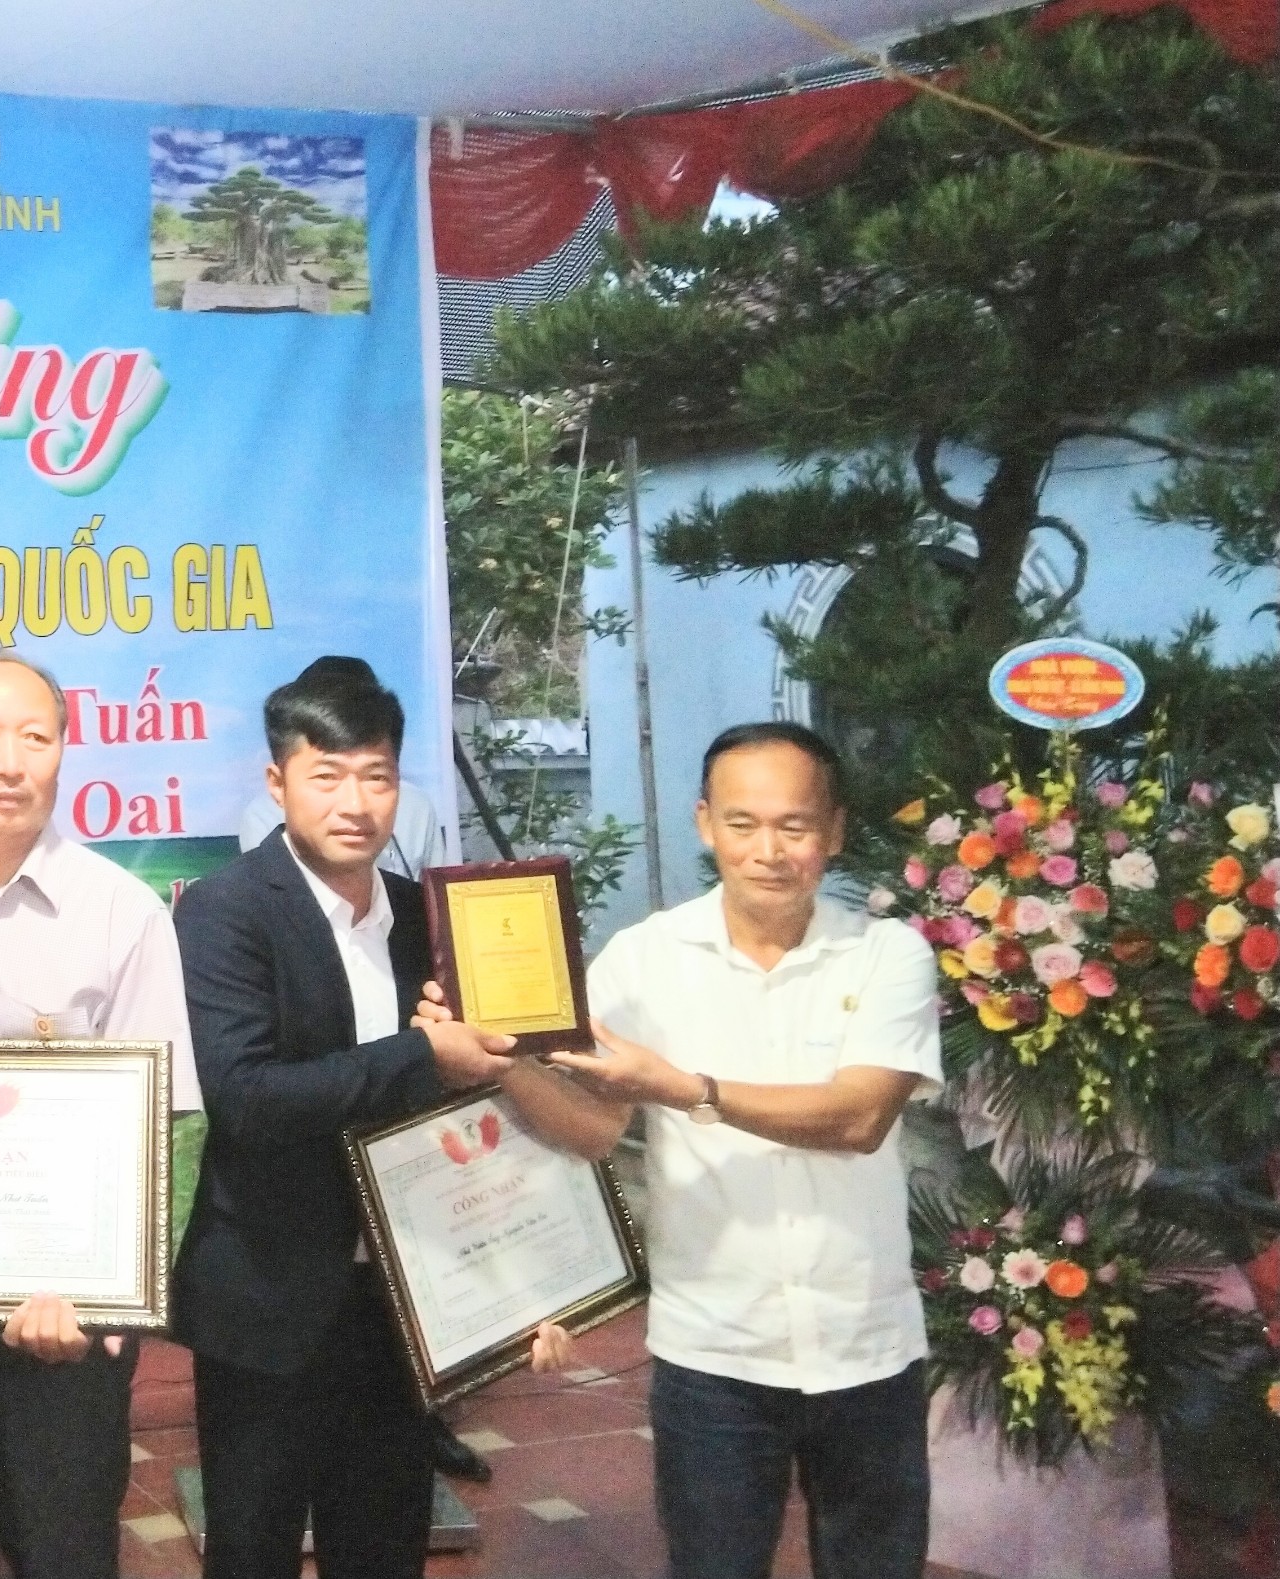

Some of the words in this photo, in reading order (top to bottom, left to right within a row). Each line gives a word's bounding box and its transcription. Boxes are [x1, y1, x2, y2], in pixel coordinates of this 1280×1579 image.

[172, 542, 274, 633] GIA
[64, 668, 209, 746] Tuấn
[72, 776, 187, 839] Oai
